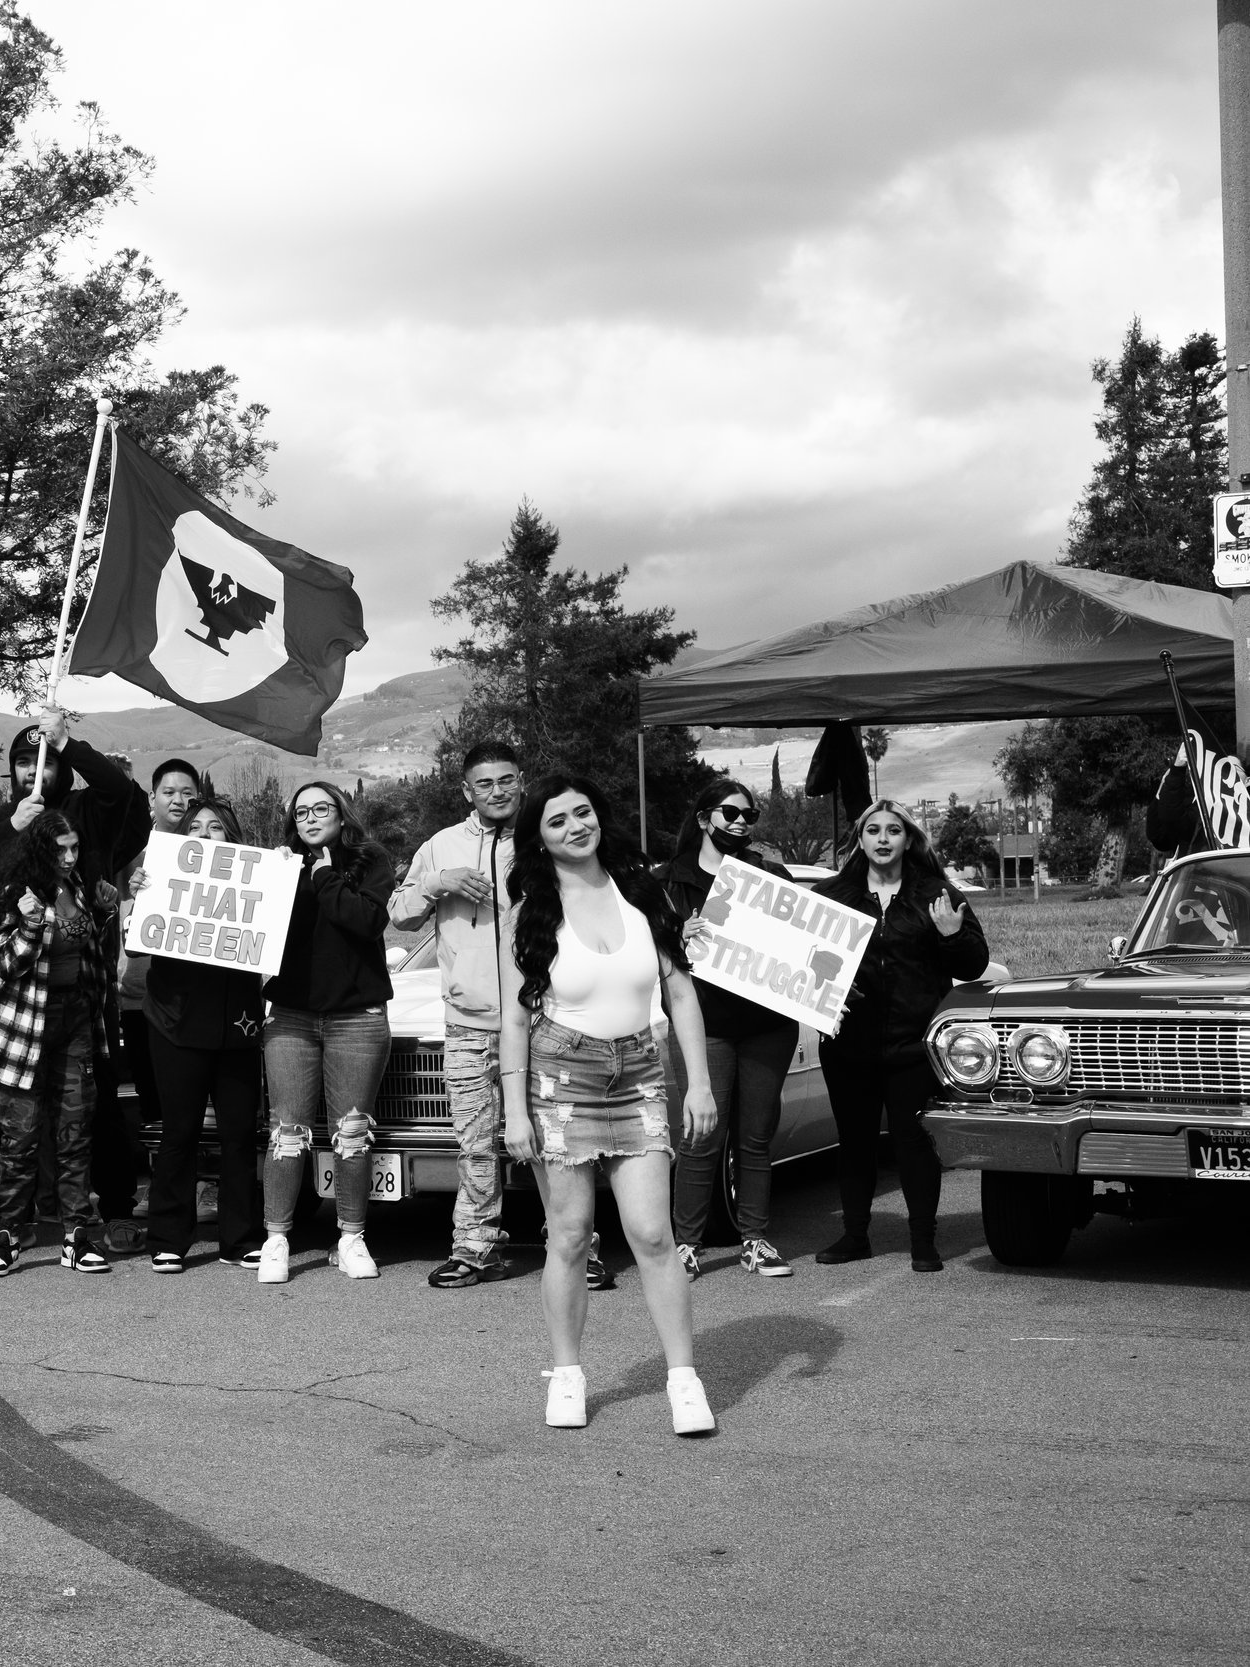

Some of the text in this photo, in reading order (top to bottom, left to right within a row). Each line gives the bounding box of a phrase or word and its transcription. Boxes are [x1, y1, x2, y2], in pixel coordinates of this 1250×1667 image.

[1225, 553, 1250, 564] SMO
[177, 840, 262, 884] GET
[168, 878, 263, 923] THAT
[714, 864, 874, 952] STABLITIY
[140, 914, 266, 965] GREEN
[685, 929, 845, 1019] STRUGGLE
[1199, 1146, 1250, 1170] V153
